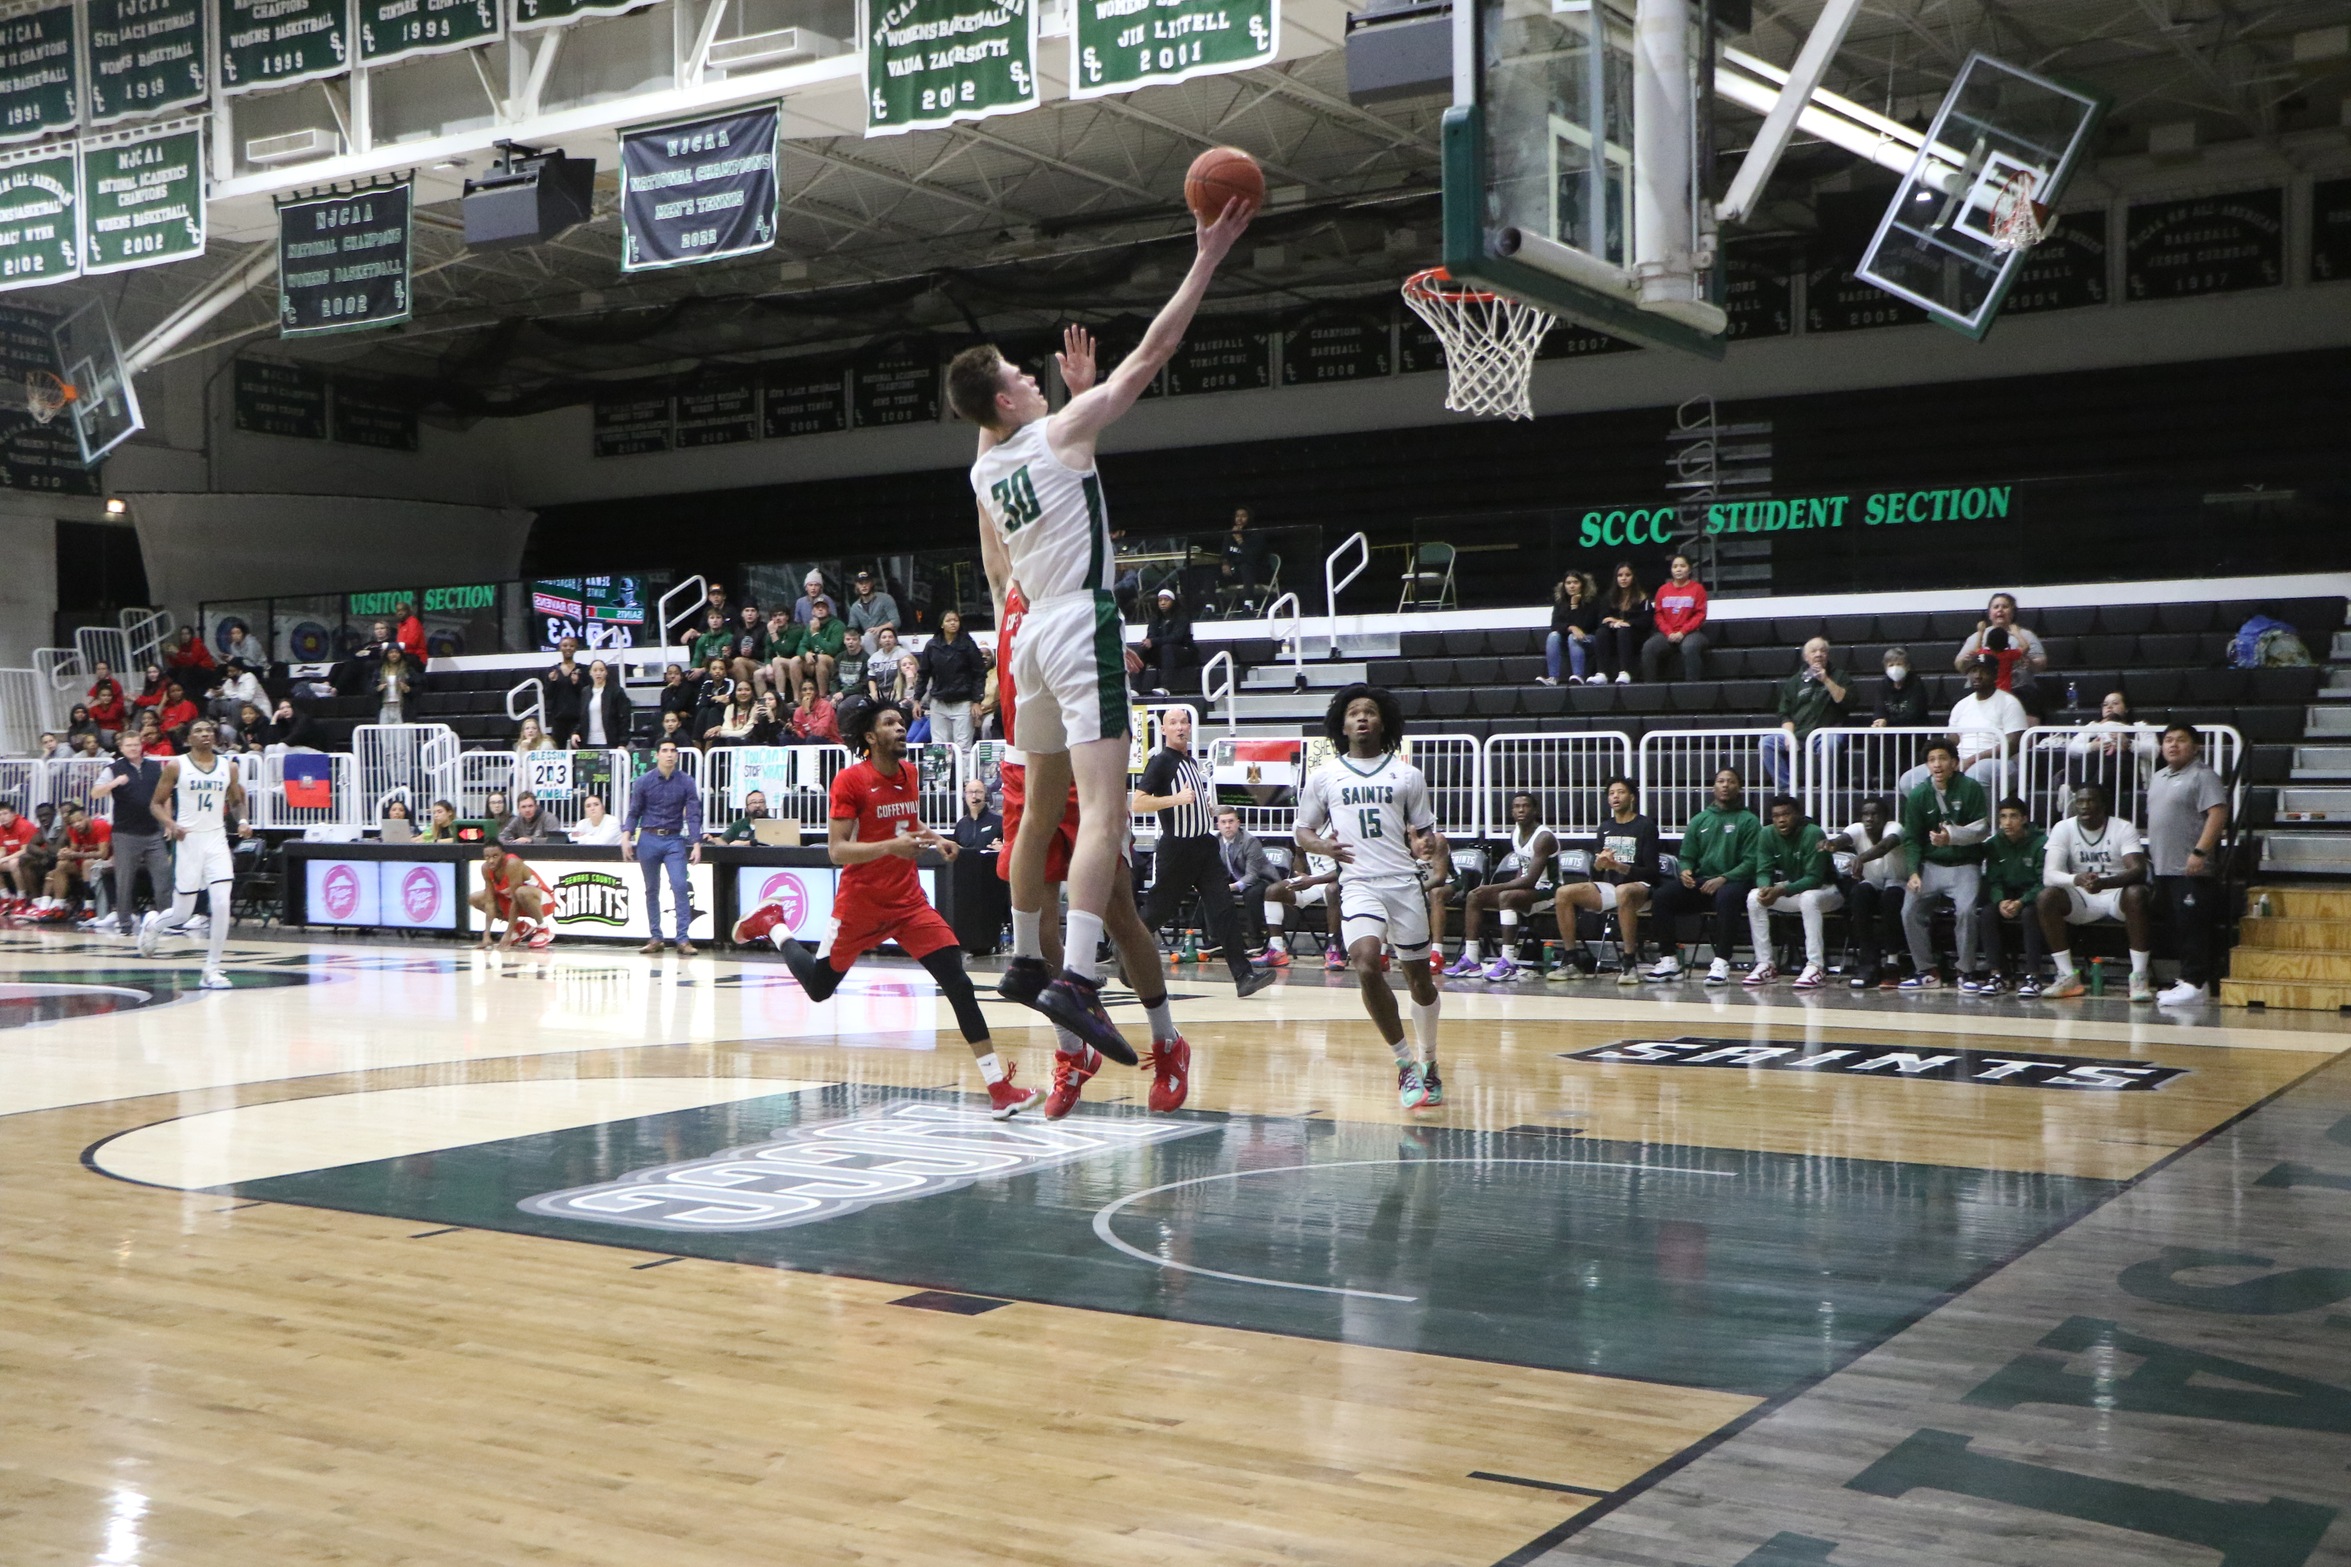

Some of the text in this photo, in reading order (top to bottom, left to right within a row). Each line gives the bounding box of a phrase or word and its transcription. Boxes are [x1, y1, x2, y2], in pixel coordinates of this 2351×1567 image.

[403, 20, 450, 41] 1999
[263, 52, 304, 74] 1999
[667, 131, 730, 157] NJCAA
[118, 146, 163, 170] NJCAA
[629, 153, 771, 192] NATIONAL CHAMPIONS
[697, 191, 744, 213] TENNIS
[316, 203, 373, 230] NJCAA
[123, 234, 164, 255] 2002
[681, 229, 717, 249] 2022
[322, 294, 367, 317] 2002
[991, 464, 1042, 533] 30
[1579, 485, 2012, 548] SCCC STUDENT SECTION
[351, 585, 496, 615] VISITOR SECTION
[1136, 712, 1144, 764] THOMAS
[744, 765, 761, 777] STOP
[191, 780, 223, 791] SAINTS
[536, 789, 573, 799] KIMBLE
[1342, 786, 1393, 806] SAINTS
[198, 794, 213, 812] 14
[1358, 808, 1383, 839] 15
[565, 873, 616, 887] SEWARD COUNTY
[553, 884, 629, 920] SAINTS
[1591, 1039, 2160, 1090] SAINTS
